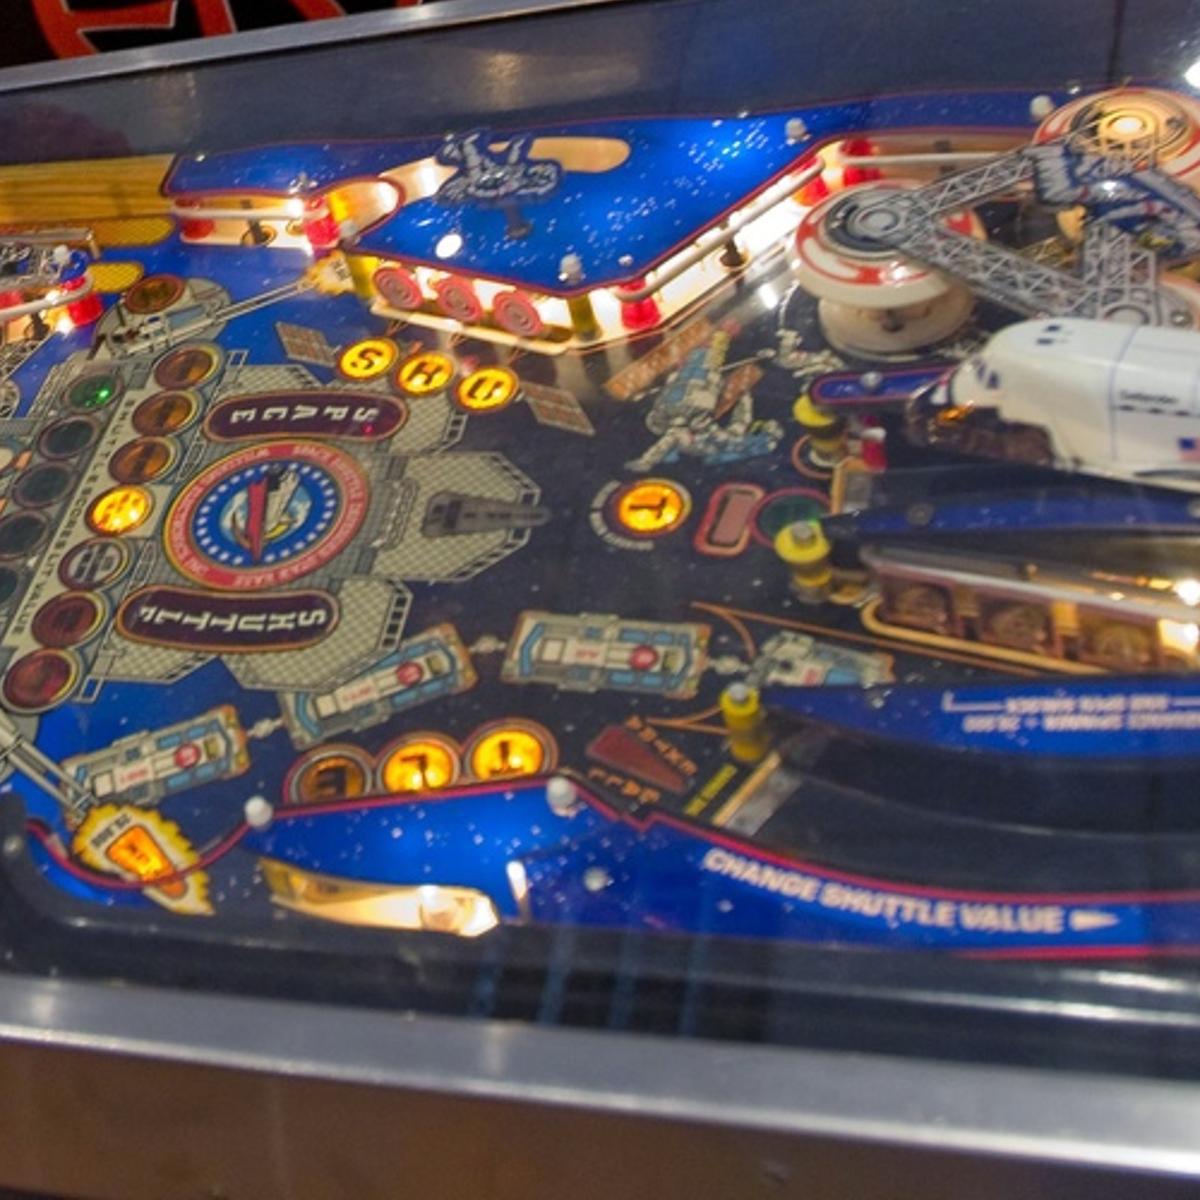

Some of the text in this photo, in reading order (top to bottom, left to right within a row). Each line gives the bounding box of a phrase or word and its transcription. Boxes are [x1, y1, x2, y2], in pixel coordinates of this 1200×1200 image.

[231, 404, 379, 424] SPACE
[139, 606, 328, 632] SHUTTLE
[704, 847, 1064, 933] CHANGE SHUTTLE VALUE
